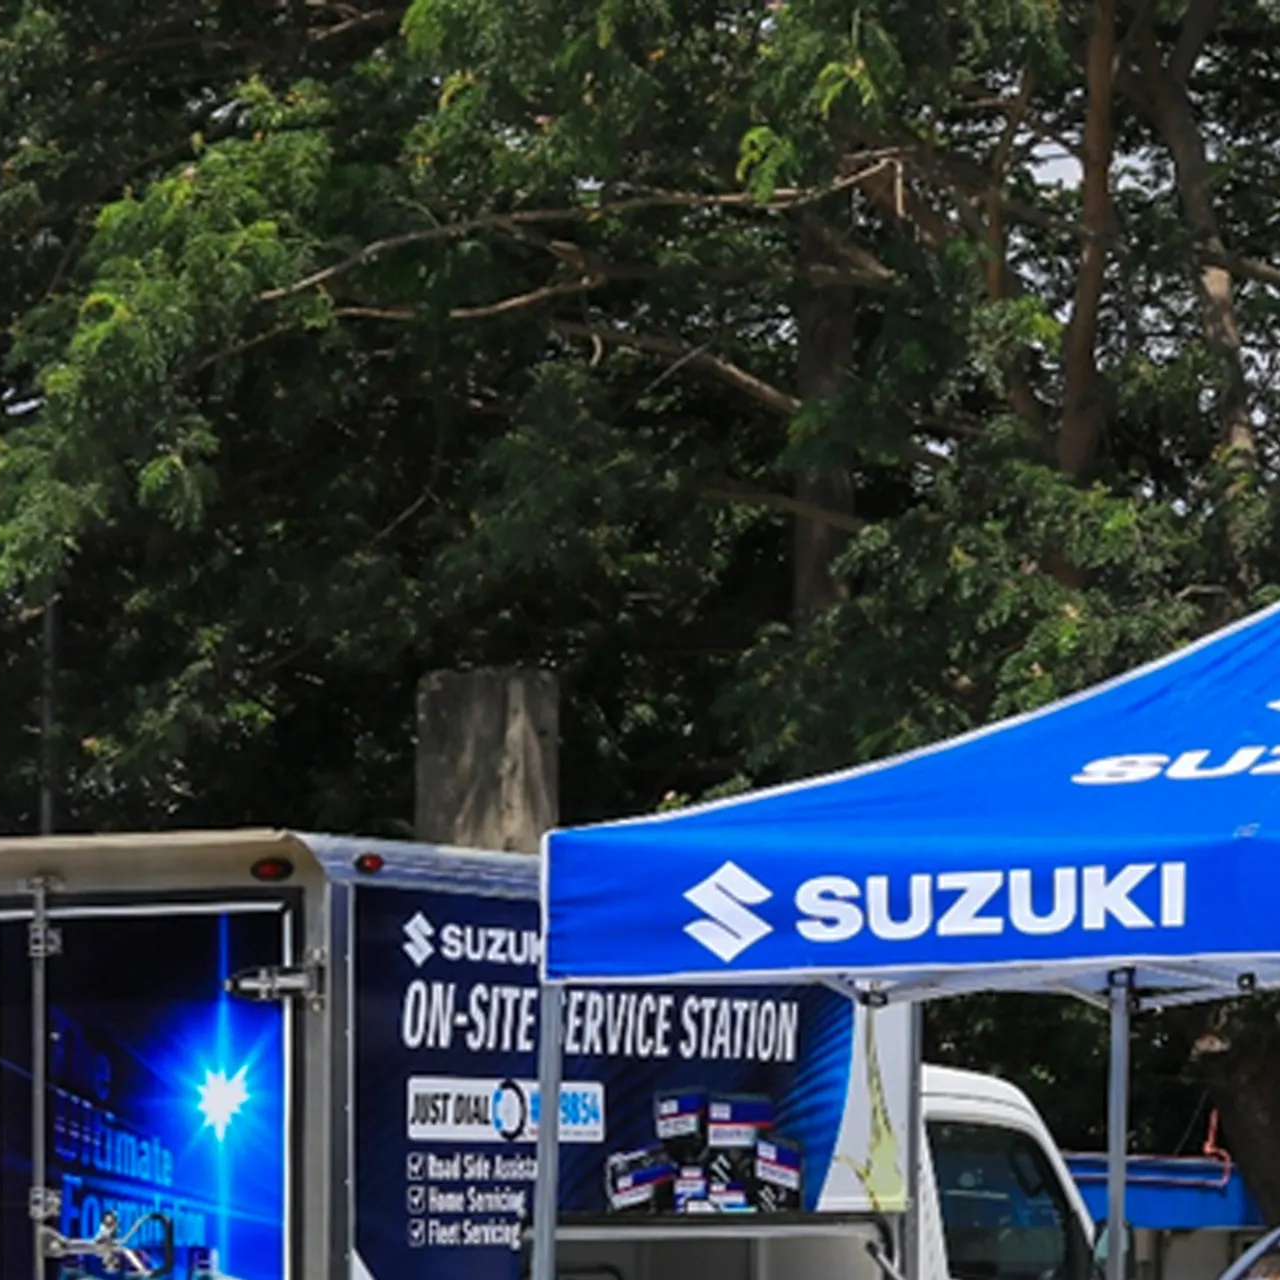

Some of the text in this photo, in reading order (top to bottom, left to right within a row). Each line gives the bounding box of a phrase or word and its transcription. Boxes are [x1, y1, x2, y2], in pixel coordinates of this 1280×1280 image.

[795, 861, 1186, 943] SUZUKI
[440, 923, 541, 964] SUZU
[403, 980, 798, 1062] ON-SITE ERVICE STATION
[411, 1092, 601, 1126] JUST DIAL #9854
[428, 1154, 538, 1181] Road Side Assista
[428, 1187, 526, 1220] Home Servicing
[428, 1219, 522, 1250] Fleet Servicing
